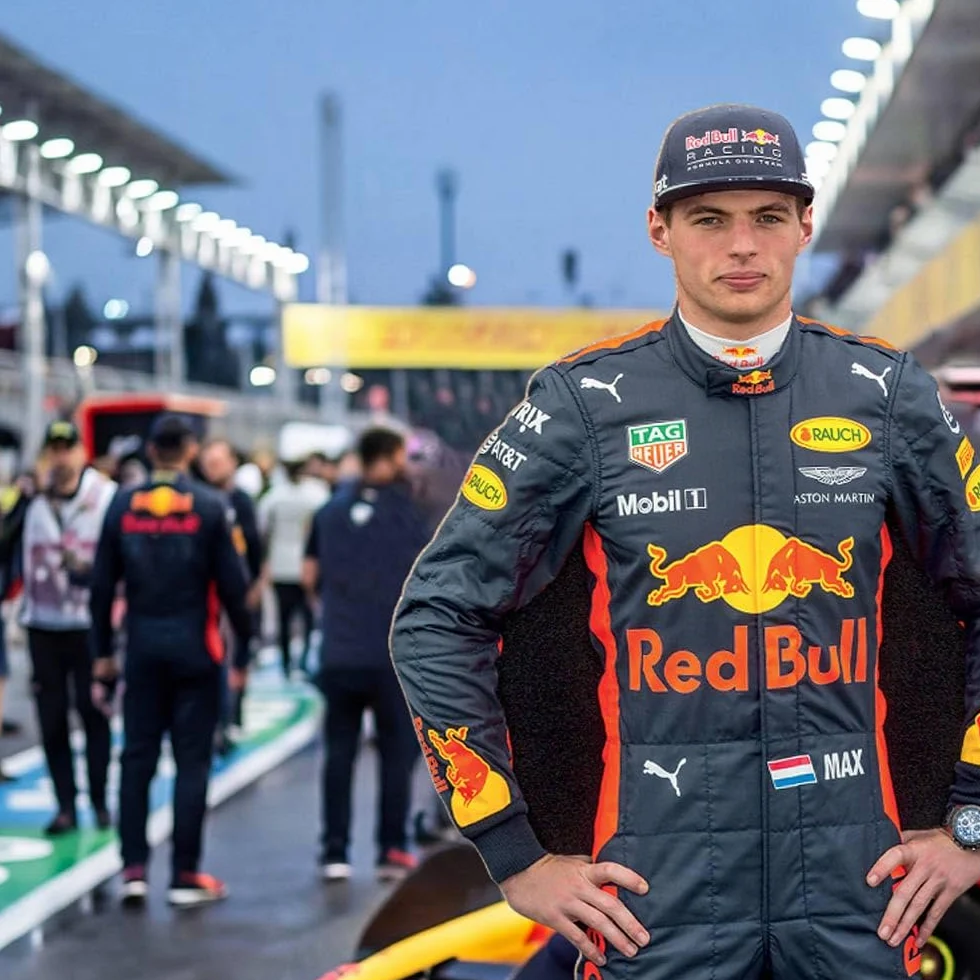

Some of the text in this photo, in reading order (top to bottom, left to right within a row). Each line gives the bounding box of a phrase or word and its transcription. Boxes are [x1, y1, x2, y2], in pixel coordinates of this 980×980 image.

[685, 127, 738, 151] Red Bull
[686, 145, 782, 161] RACING
[731, 380, 776, 394] Red Bull
[632, 424, 682, 444] TAG
[812, 427, 862, 443] RAUCH
[490, 438, 528, 472] AT&T
[632, 442, 684, 468] HEUER
[468, 473, 502, 505] RAUCH
[793, 491, 876, 505] ASTON MARTIN
[616, 489, 681, 517] Mobil
[626, 617, 868, 694] Red Bull
[822, 748, 866, 781] MAX
